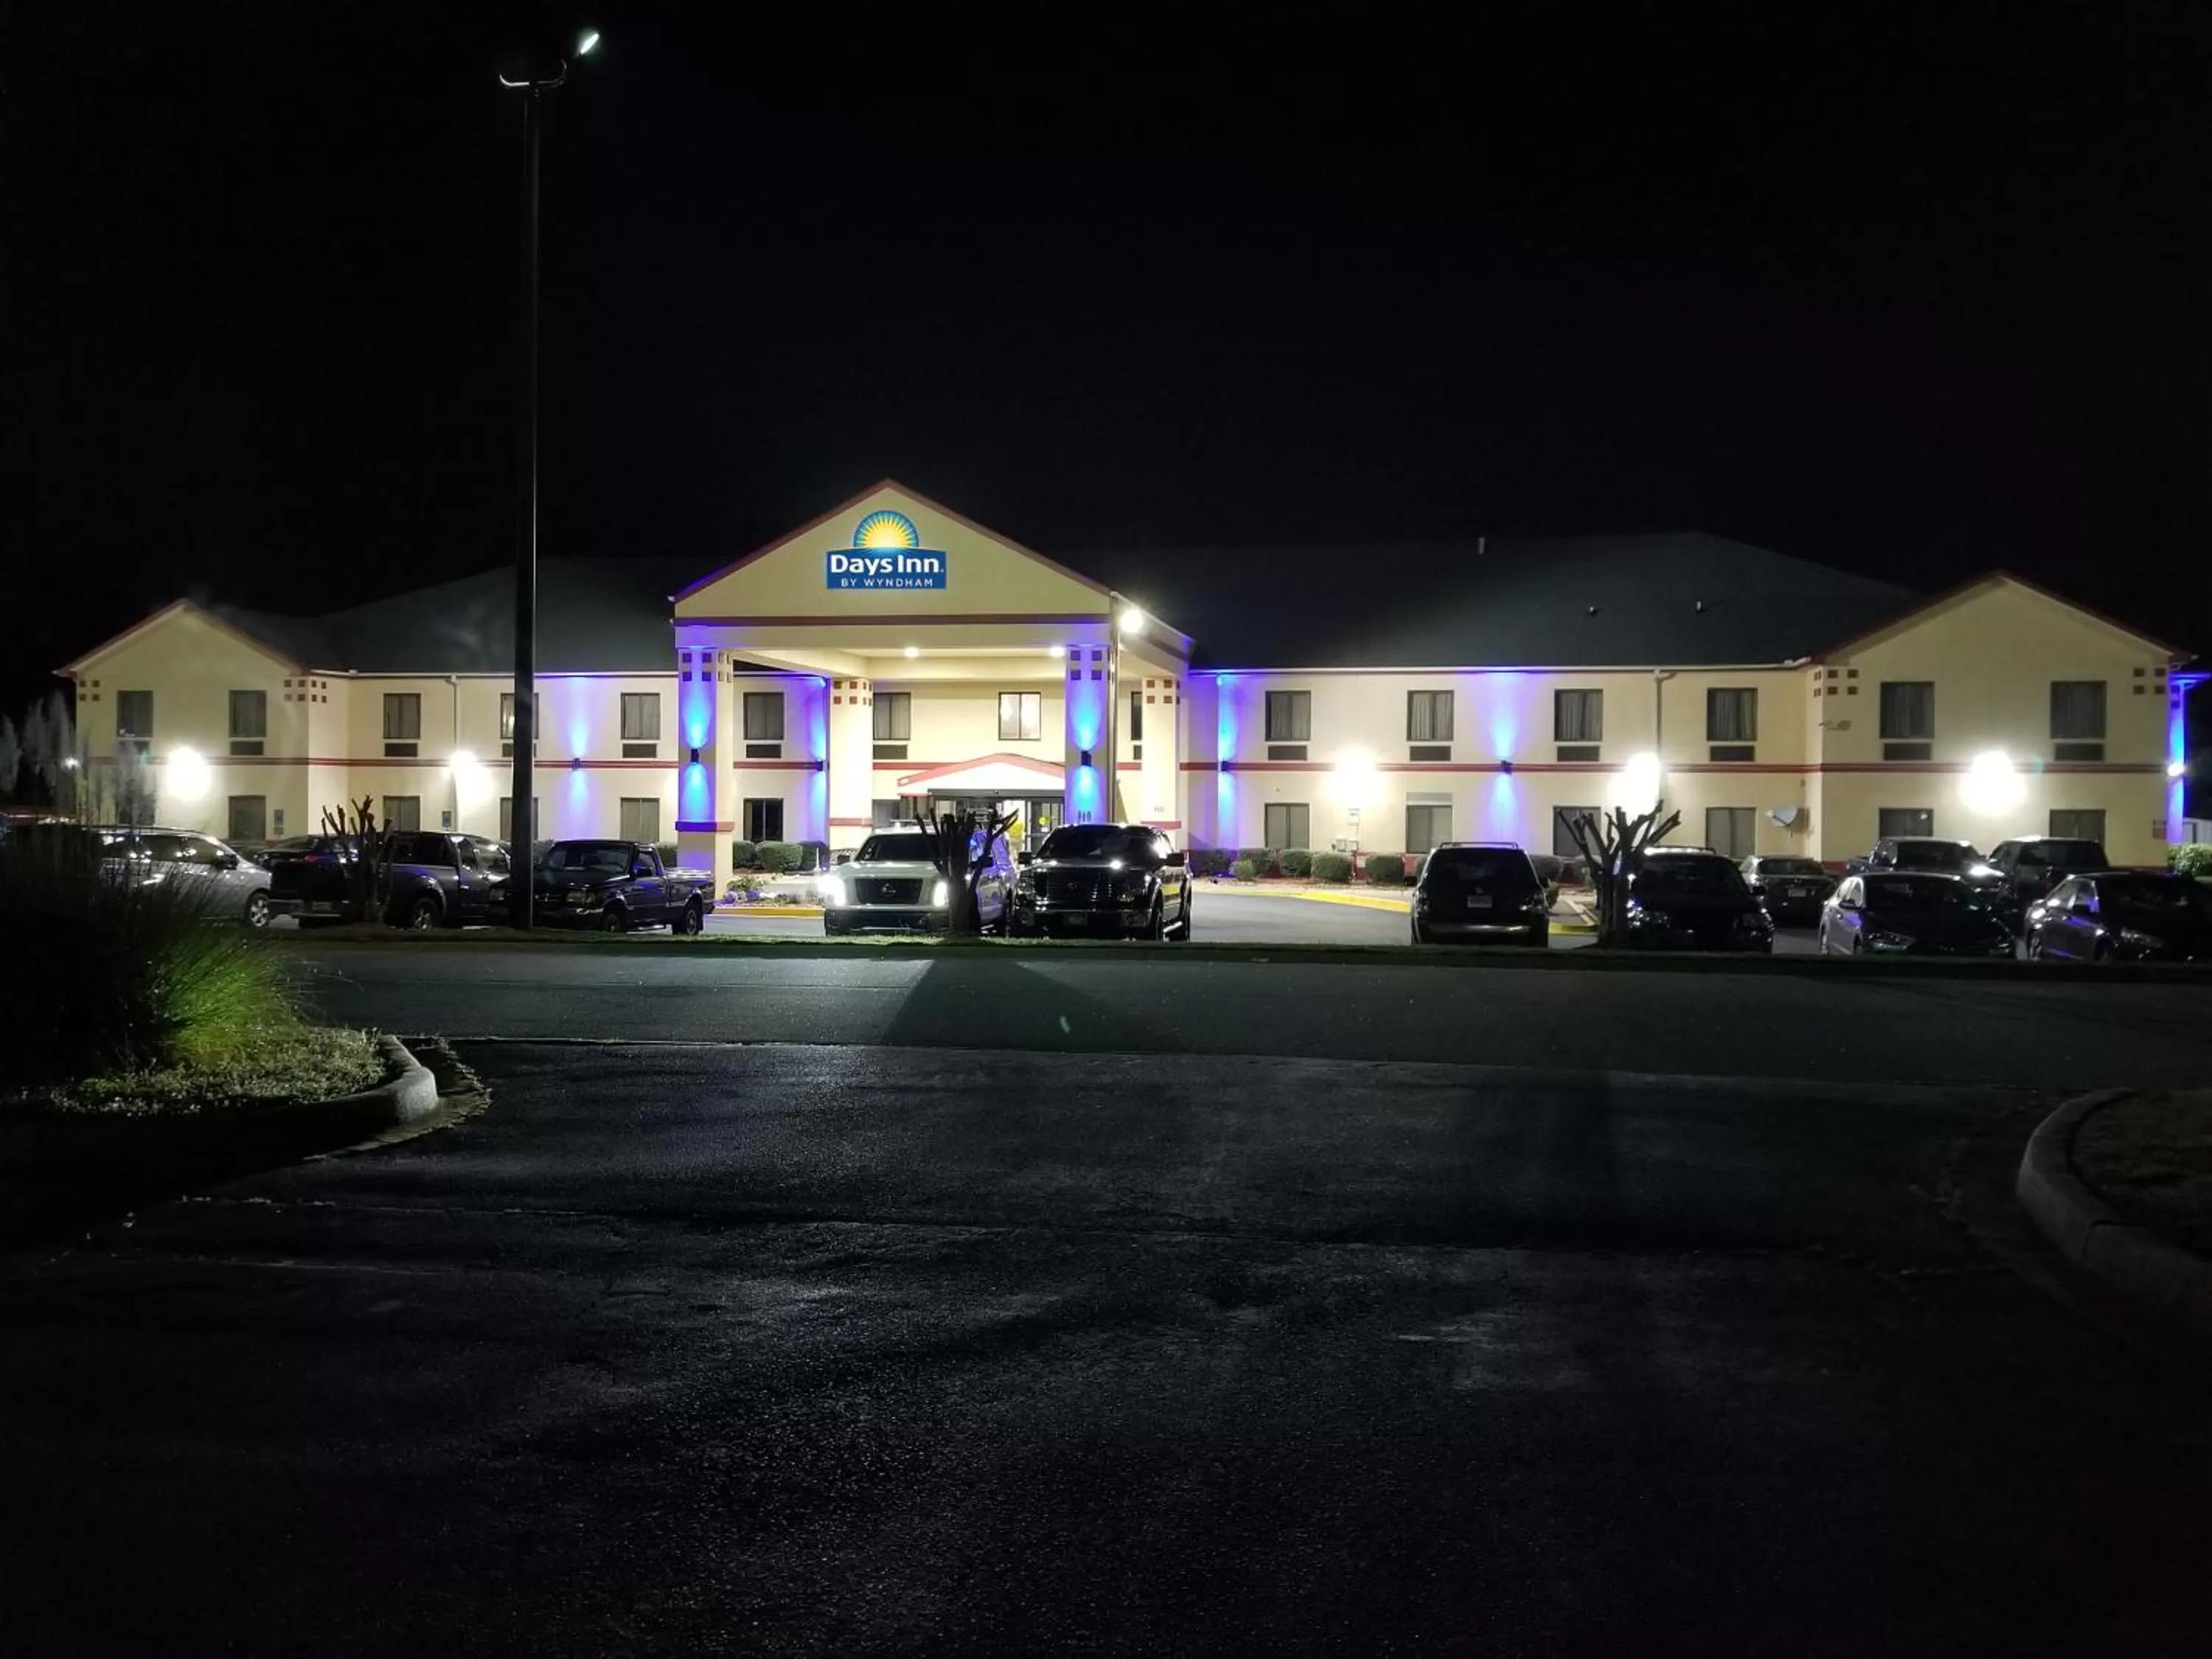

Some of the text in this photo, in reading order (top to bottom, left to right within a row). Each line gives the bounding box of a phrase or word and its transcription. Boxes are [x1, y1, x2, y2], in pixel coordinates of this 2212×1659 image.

[830, 554, 939, 575] Days Inn
[841, 578, 933, 587] BY WYNDHAM
